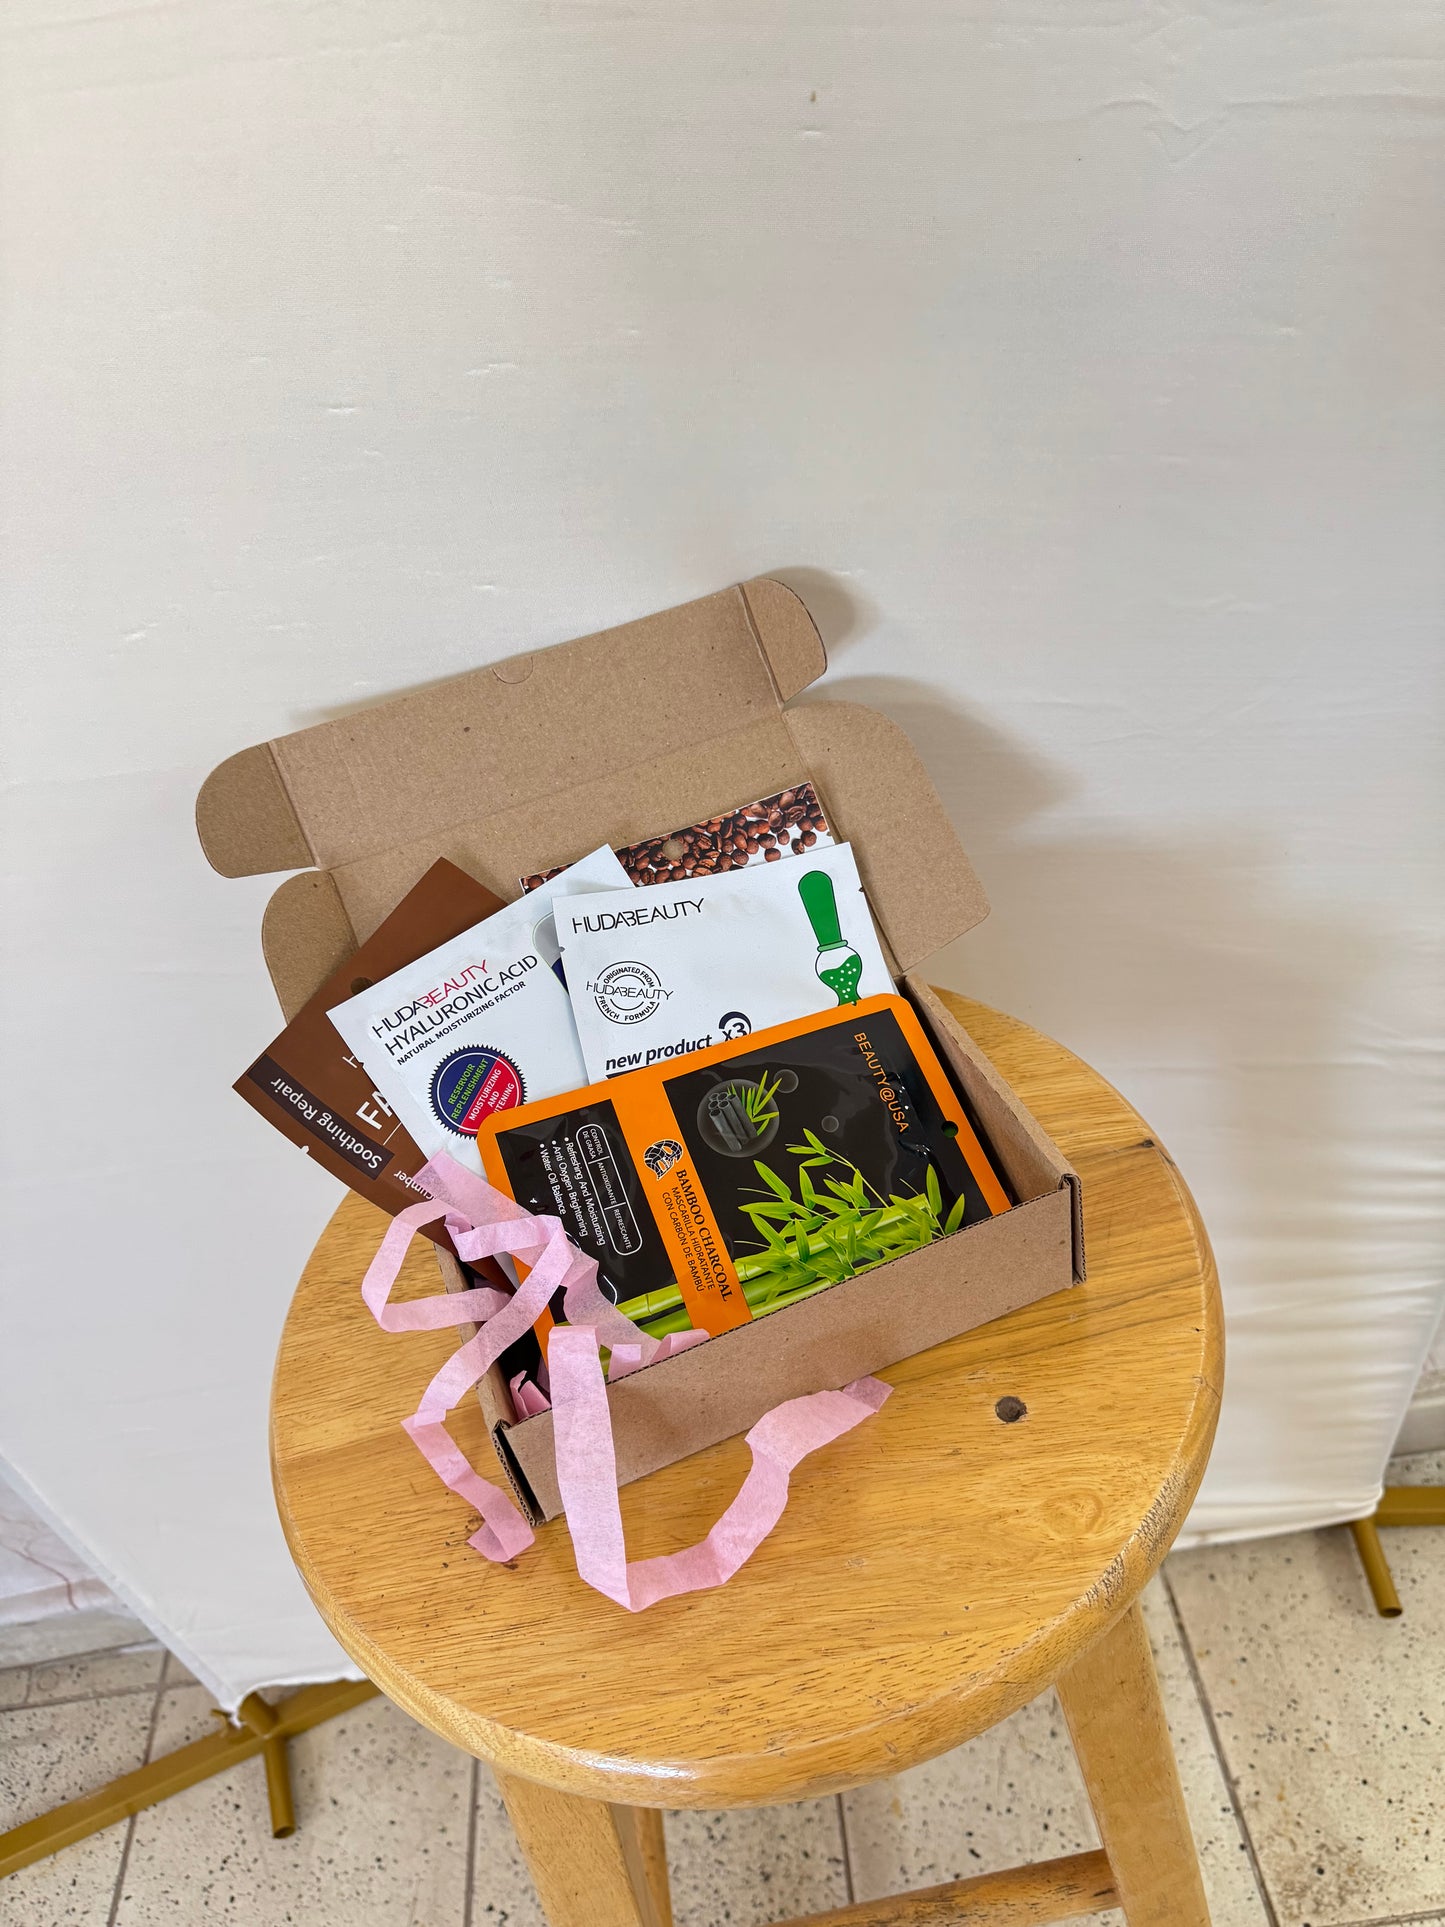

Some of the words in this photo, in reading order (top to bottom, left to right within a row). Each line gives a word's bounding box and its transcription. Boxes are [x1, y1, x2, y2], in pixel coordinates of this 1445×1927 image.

[572, 897, 704, 934] HUDABEAUTY
[586, 980, 674, 1001] HUDABEAUTY
[603, 966, 641, 985] ORIGINATED
[639, 970, 656, 988] FROM
[372, 959, 489, 1039] HUDABEAUTY
[385, 977, 499, 1056] HYALURONIC
[498, 955, 538, 986] ACID
[598, 995, 620, 1020] FRENCH
[624, 1001, 656, 1022] FORMULA
[397, 1037, 436, 1066] NATURAL
[435, 999, 495, 1040] MOISTURIZING
[494, 980, 526, 1004] FACTOR
[605, 1051, 643, 1071] new
[645, 1034, 713, 1066] product
[270, 1077, 318, 1121] Repair
[447, 1063, 476, 1105] RESERVOIR
[450, 1057, 489, 1120] REPLENISHMENT
[468, 1068, 502, 1121] MOISTURIZING
[487, 1090, 500, 1108] AND
[492, 1082, 515, 1113] ITENING
[854, 1032, 910, 1133] BEAUTY@USA
[316, 1112, 383, 1170] Soothing
[582, 1130, 590, 1141] DE
[585, 1140, 596, 1159] GRASA
[589, 1128, 604, 1155] CONTROL
[540, 1149, 552, 1172] Water
[553, 1146, 566, 1162] Anti
[565, 1142, 584, 1180] Refreshing
[393, 1170, 435, 1200] cumber
[548, 1173, 558, 1185] Oil
[558, 1162, 573, 1191] Oxygen
[579, 1181, 592, 1197] And
[597, 1162, 617, 1205] ANTIOXIDANTE
[552, 1185, 567, 1215] Balance
[568, 1191, 588, 1237] Brightening
[662, 1191, 675, 1212] CON
[585, 1197, 606, 1246] Moisturizing
[613, 1208, 632, 1250] REFRESCANTE
[669, 1211, 687, 1246] CARBÓN
[671, 1186, 695, 1237] MASCARILLA
[691, 1237, 716, 1291] HIDRATANTE
[676, 1168, 705, 1225] BAMBOO
[698, 1226, 733, 1302] CHARCOAL
[683, 1246, 693, 1259] DE
[687, 1259, 705, 1292] BAMBÚ
